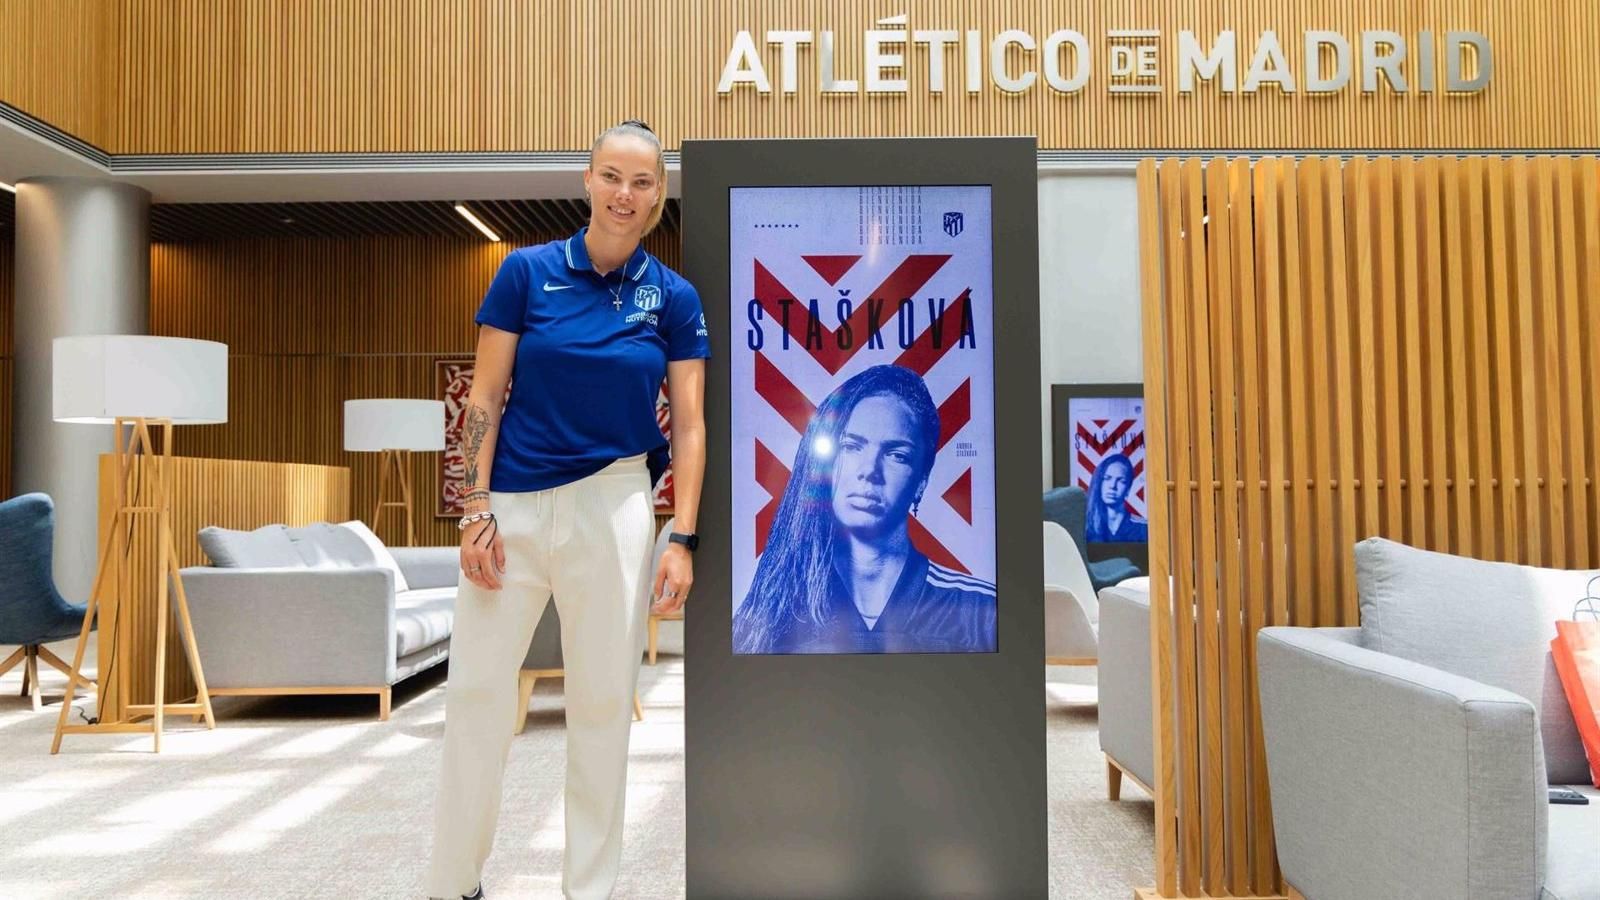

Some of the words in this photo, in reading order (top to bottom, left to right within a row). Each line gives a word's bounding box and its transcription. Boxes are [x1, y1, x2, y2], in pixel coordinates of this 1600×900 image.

[716, 14, 1092, 95] ATLÉTICO
[1110, 45, 1157, 78] DE
[1178, 29, 1493, 95] MADRID
[747, 286, 977, 351] STAŠKOVÁ
